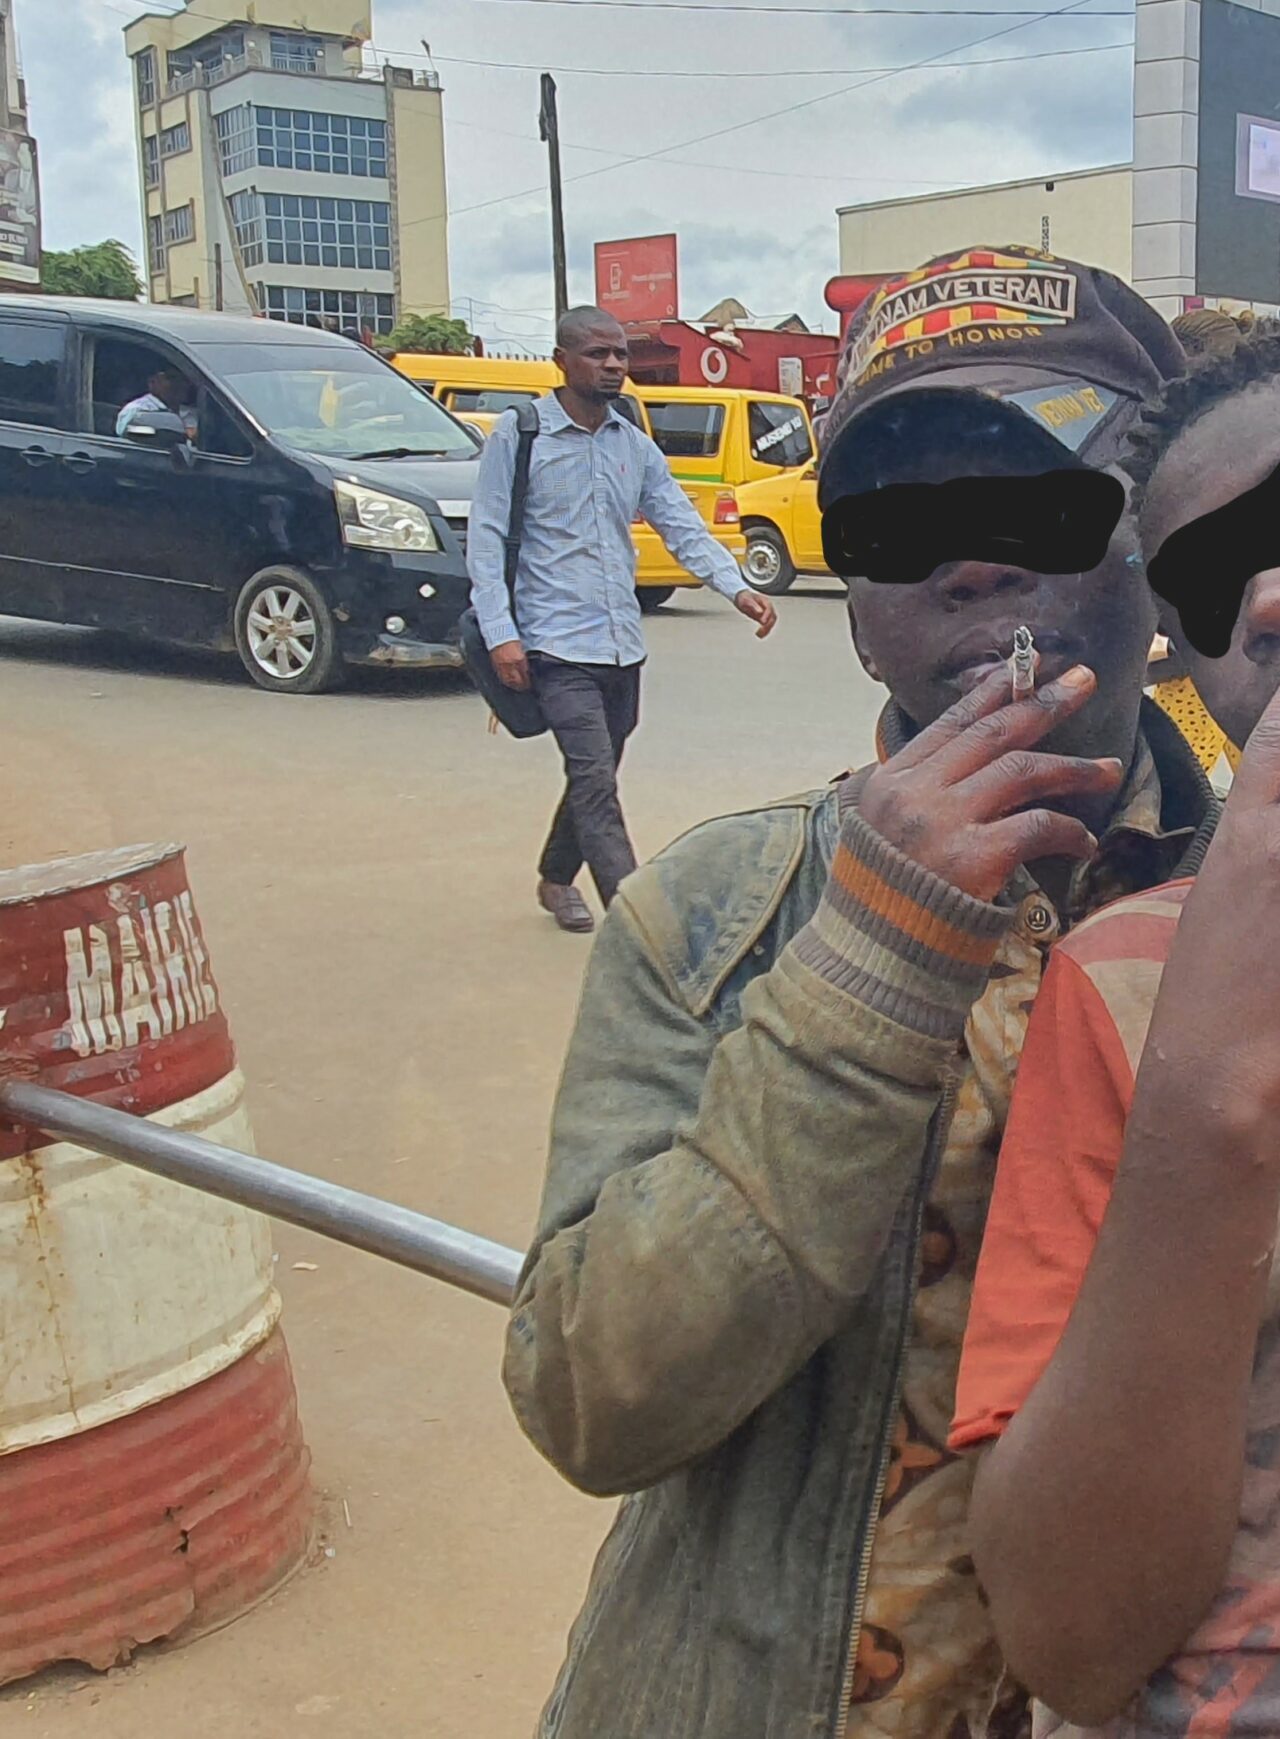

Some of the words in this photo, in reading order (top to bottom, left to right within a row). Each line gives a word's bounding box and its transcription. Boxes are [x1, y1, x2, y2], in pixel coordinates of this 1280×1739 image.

[932, 275, 1063, 310] VETERAN
[904, 340, 933, 359] TO
[949, 326, 1044, 348] HONOR
